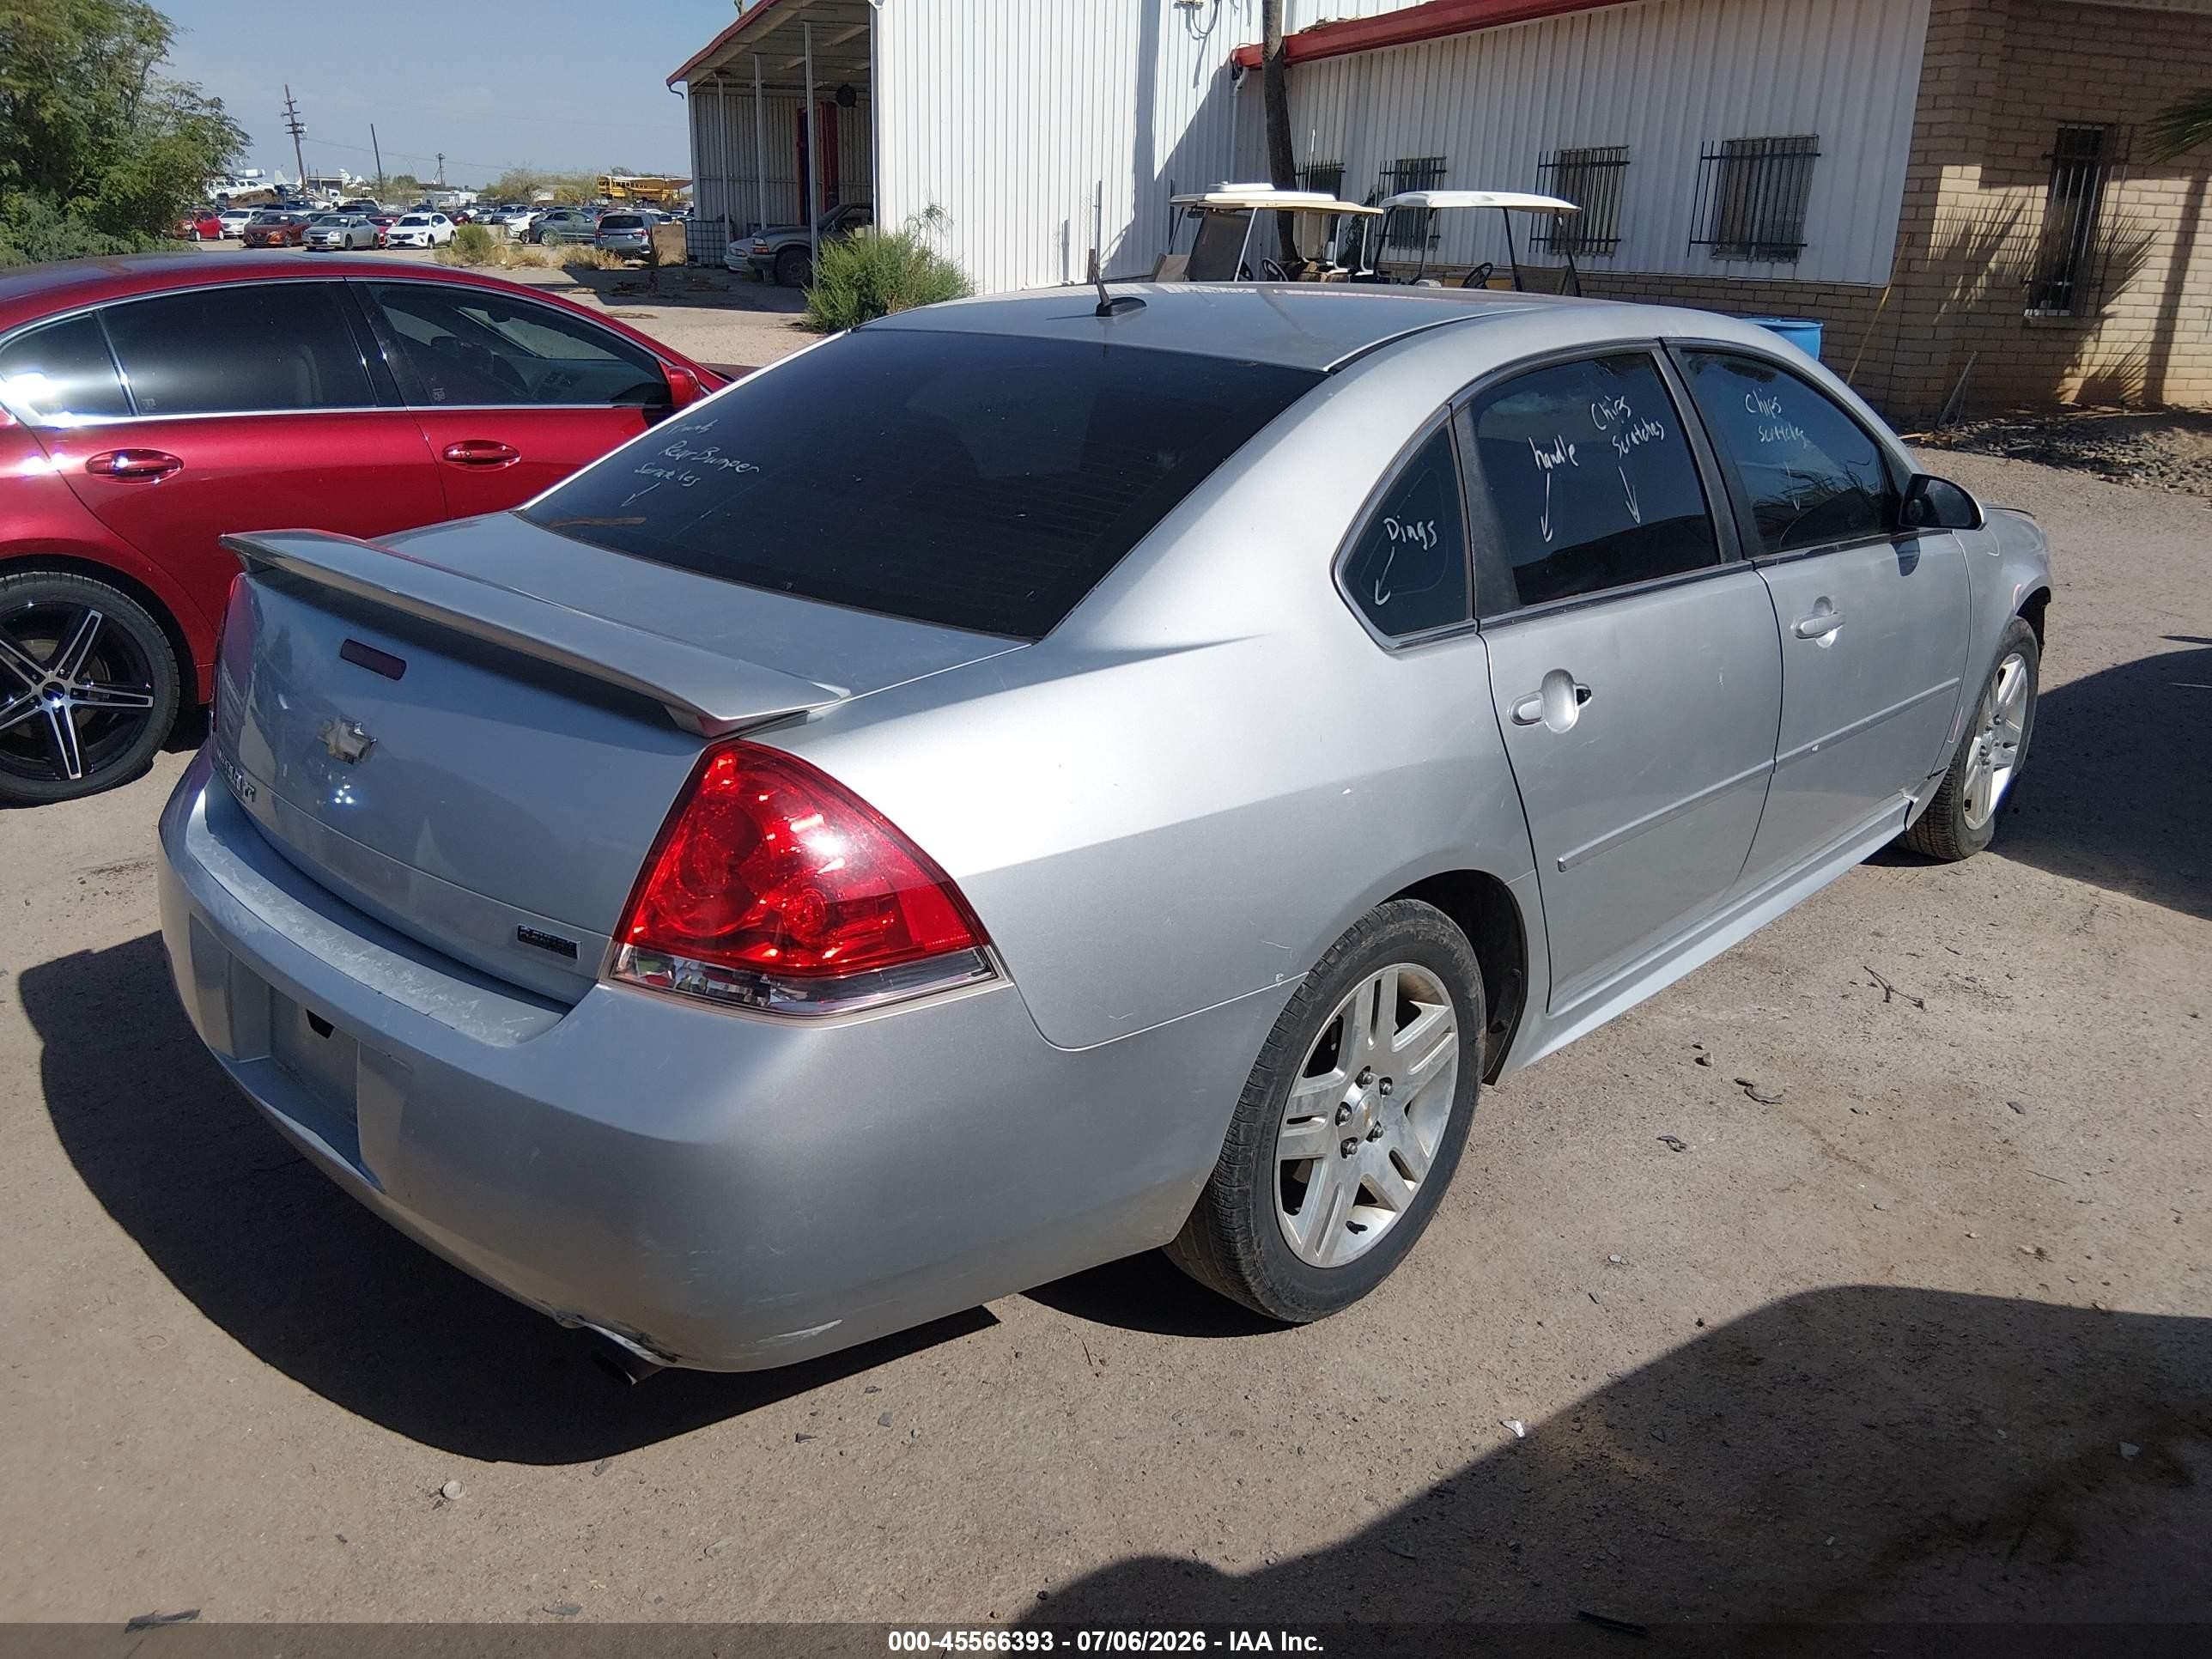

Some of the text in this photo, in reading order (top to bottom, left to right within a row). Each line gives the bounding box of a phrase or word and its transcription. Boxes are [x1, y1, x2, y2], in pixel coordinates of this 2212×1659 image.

[1745, 387, 1782, 419] Chips
[1528, 434, 1579, 471] handle
[1382, 515, 1437, 550] Dings
